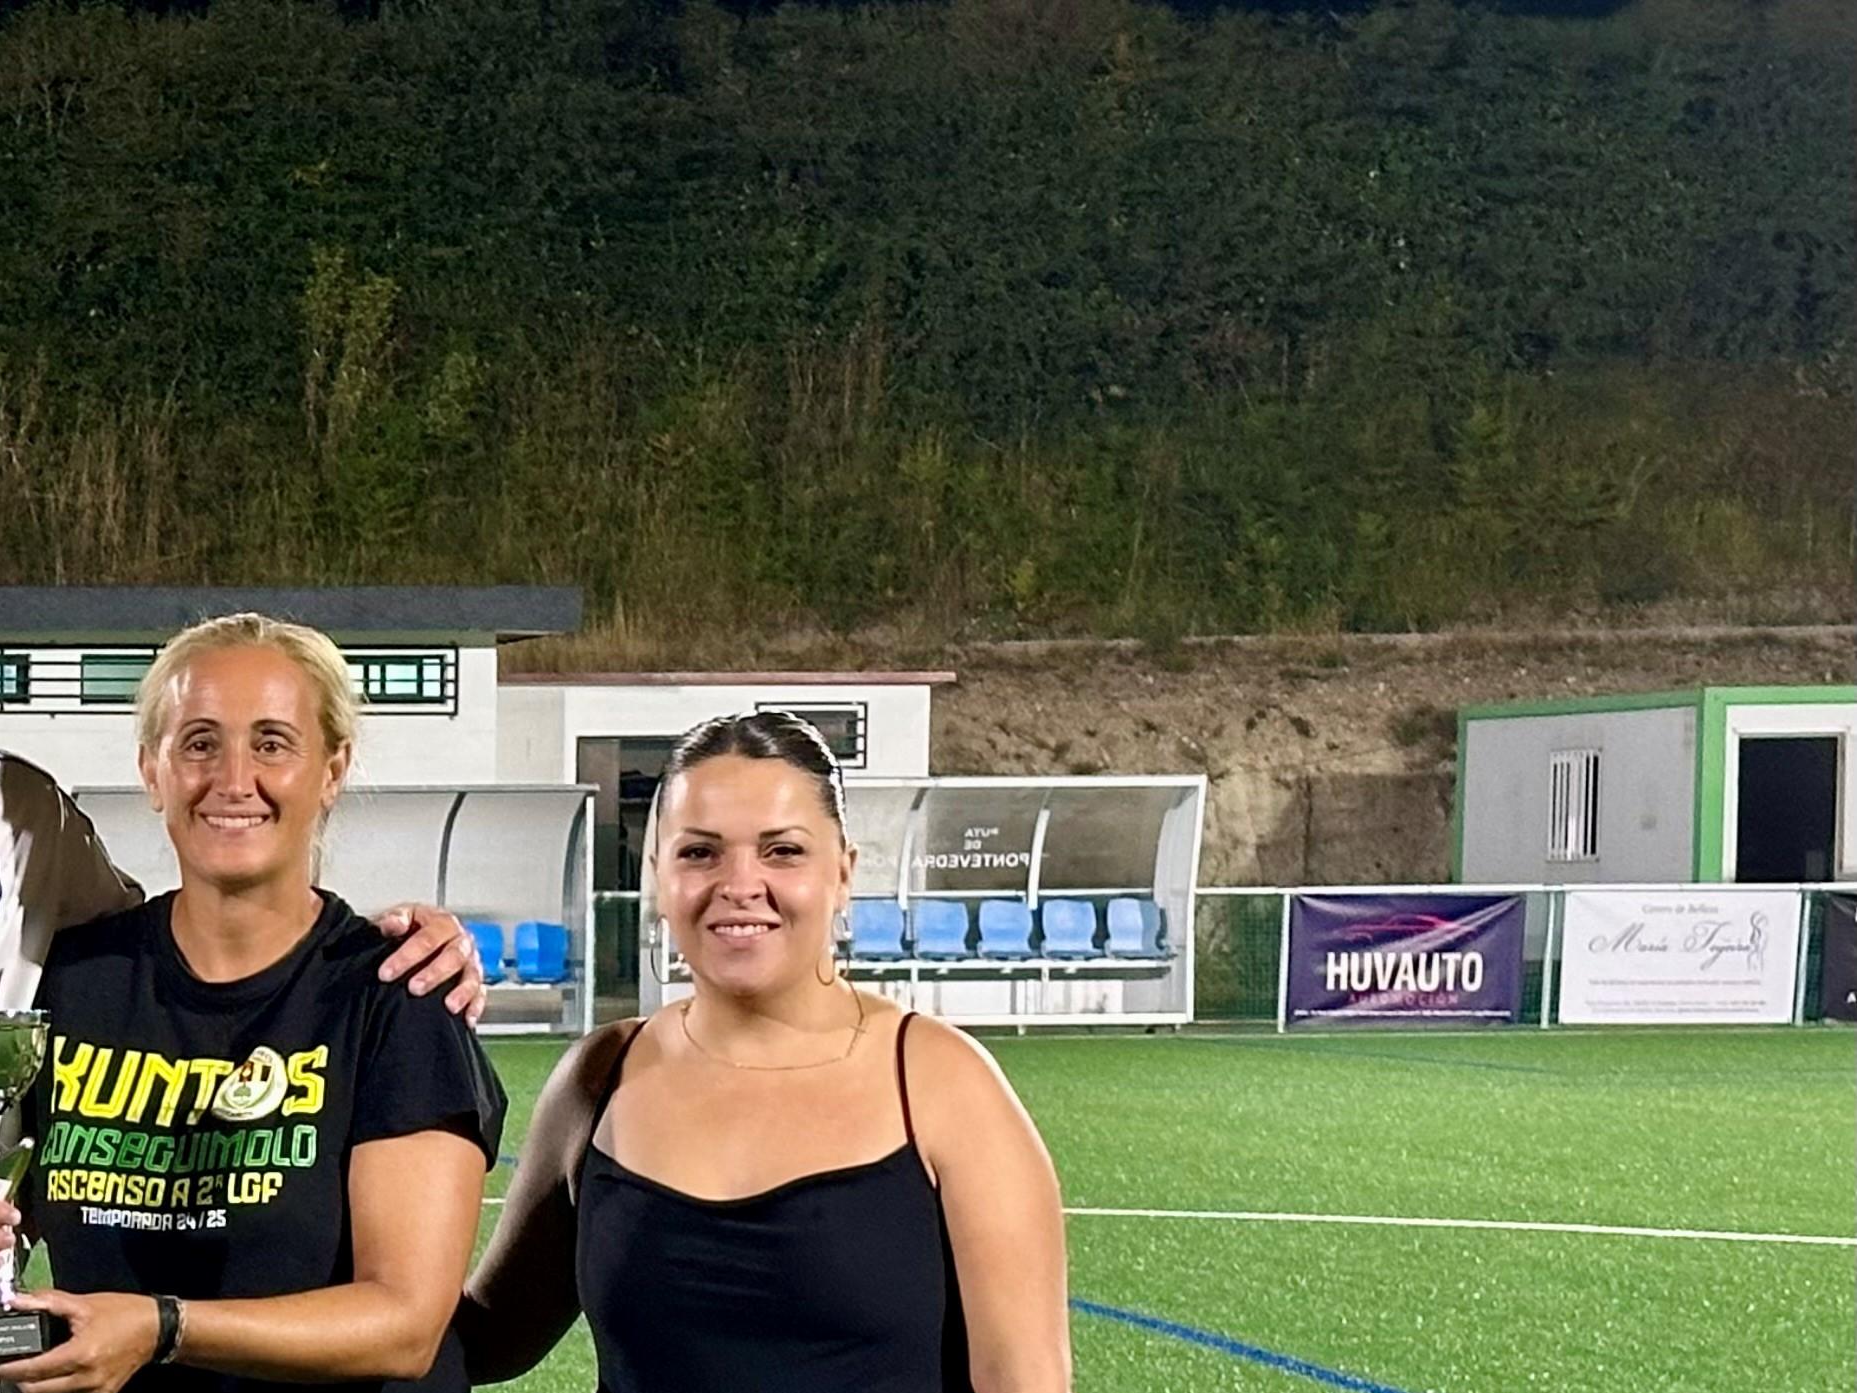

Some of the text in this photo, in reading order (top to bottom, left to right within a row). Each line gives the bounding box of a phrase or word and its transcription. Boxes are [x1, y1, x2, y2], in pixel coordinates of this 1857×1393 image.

[1326, 952, 1484, 991] HUVAUTO
[170, 1177, 190, 1208] A
[227, 1171, 283, 1204] LGF
